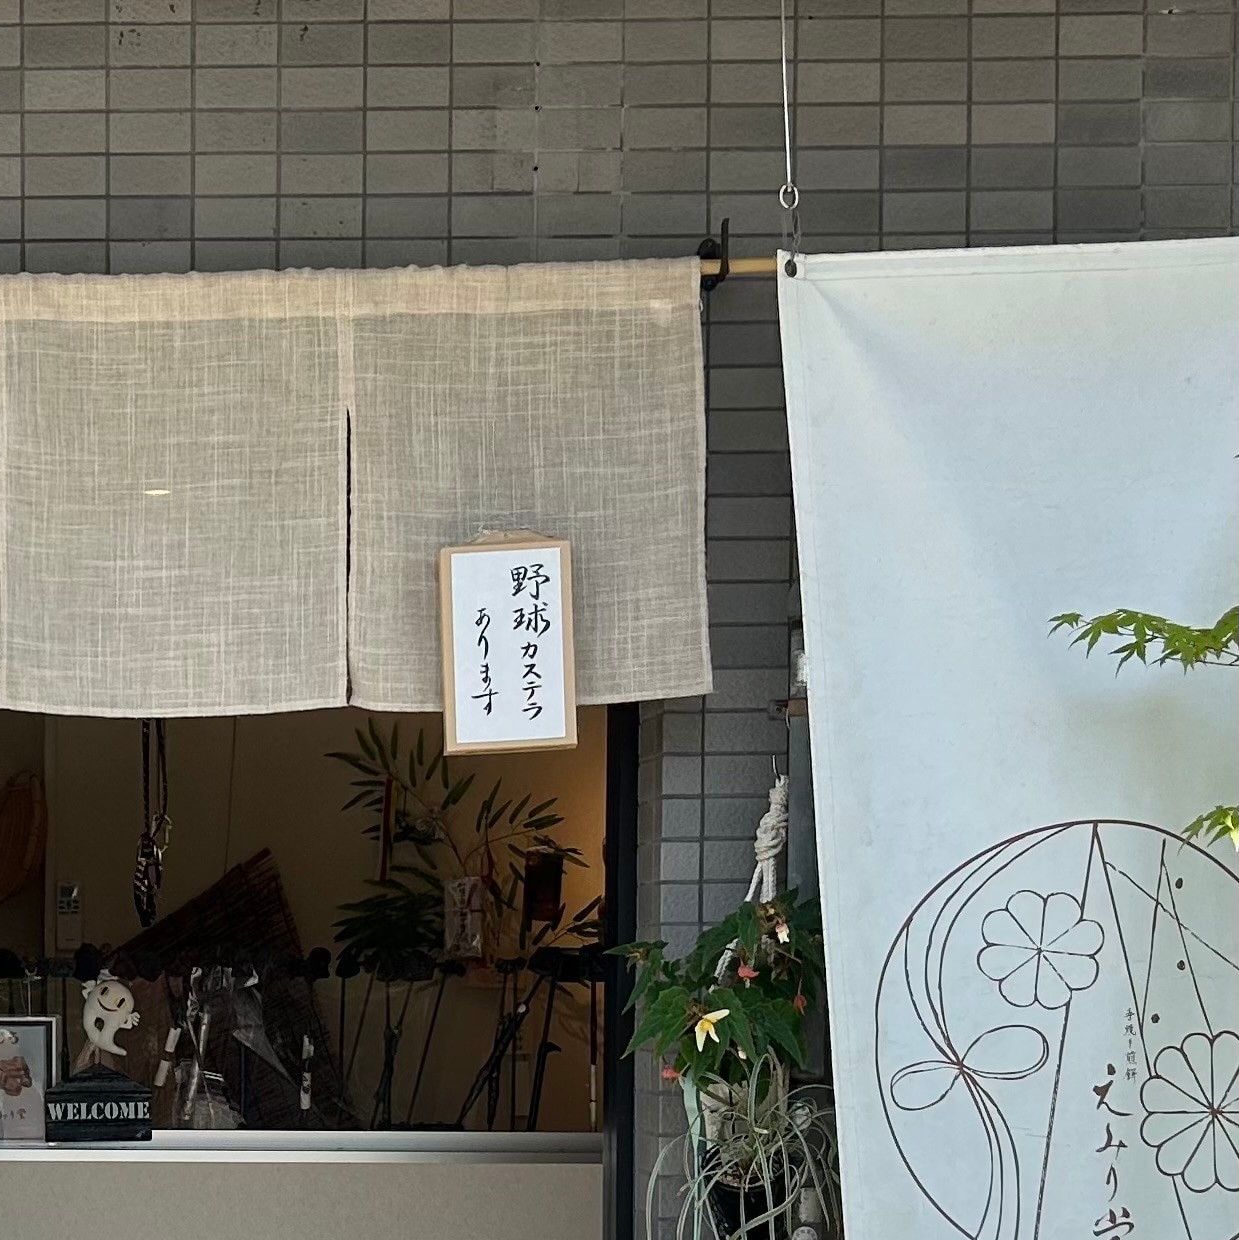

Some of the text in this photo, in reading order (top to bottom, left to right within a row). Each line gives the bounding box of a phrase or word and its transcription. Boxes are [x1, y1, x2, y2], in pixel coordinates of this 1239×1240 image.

[471, 607, 500, 716] あります
[510, 563, 551, 721] 野球カステラ
[47, 1101, 150, 1121] WELCOME
